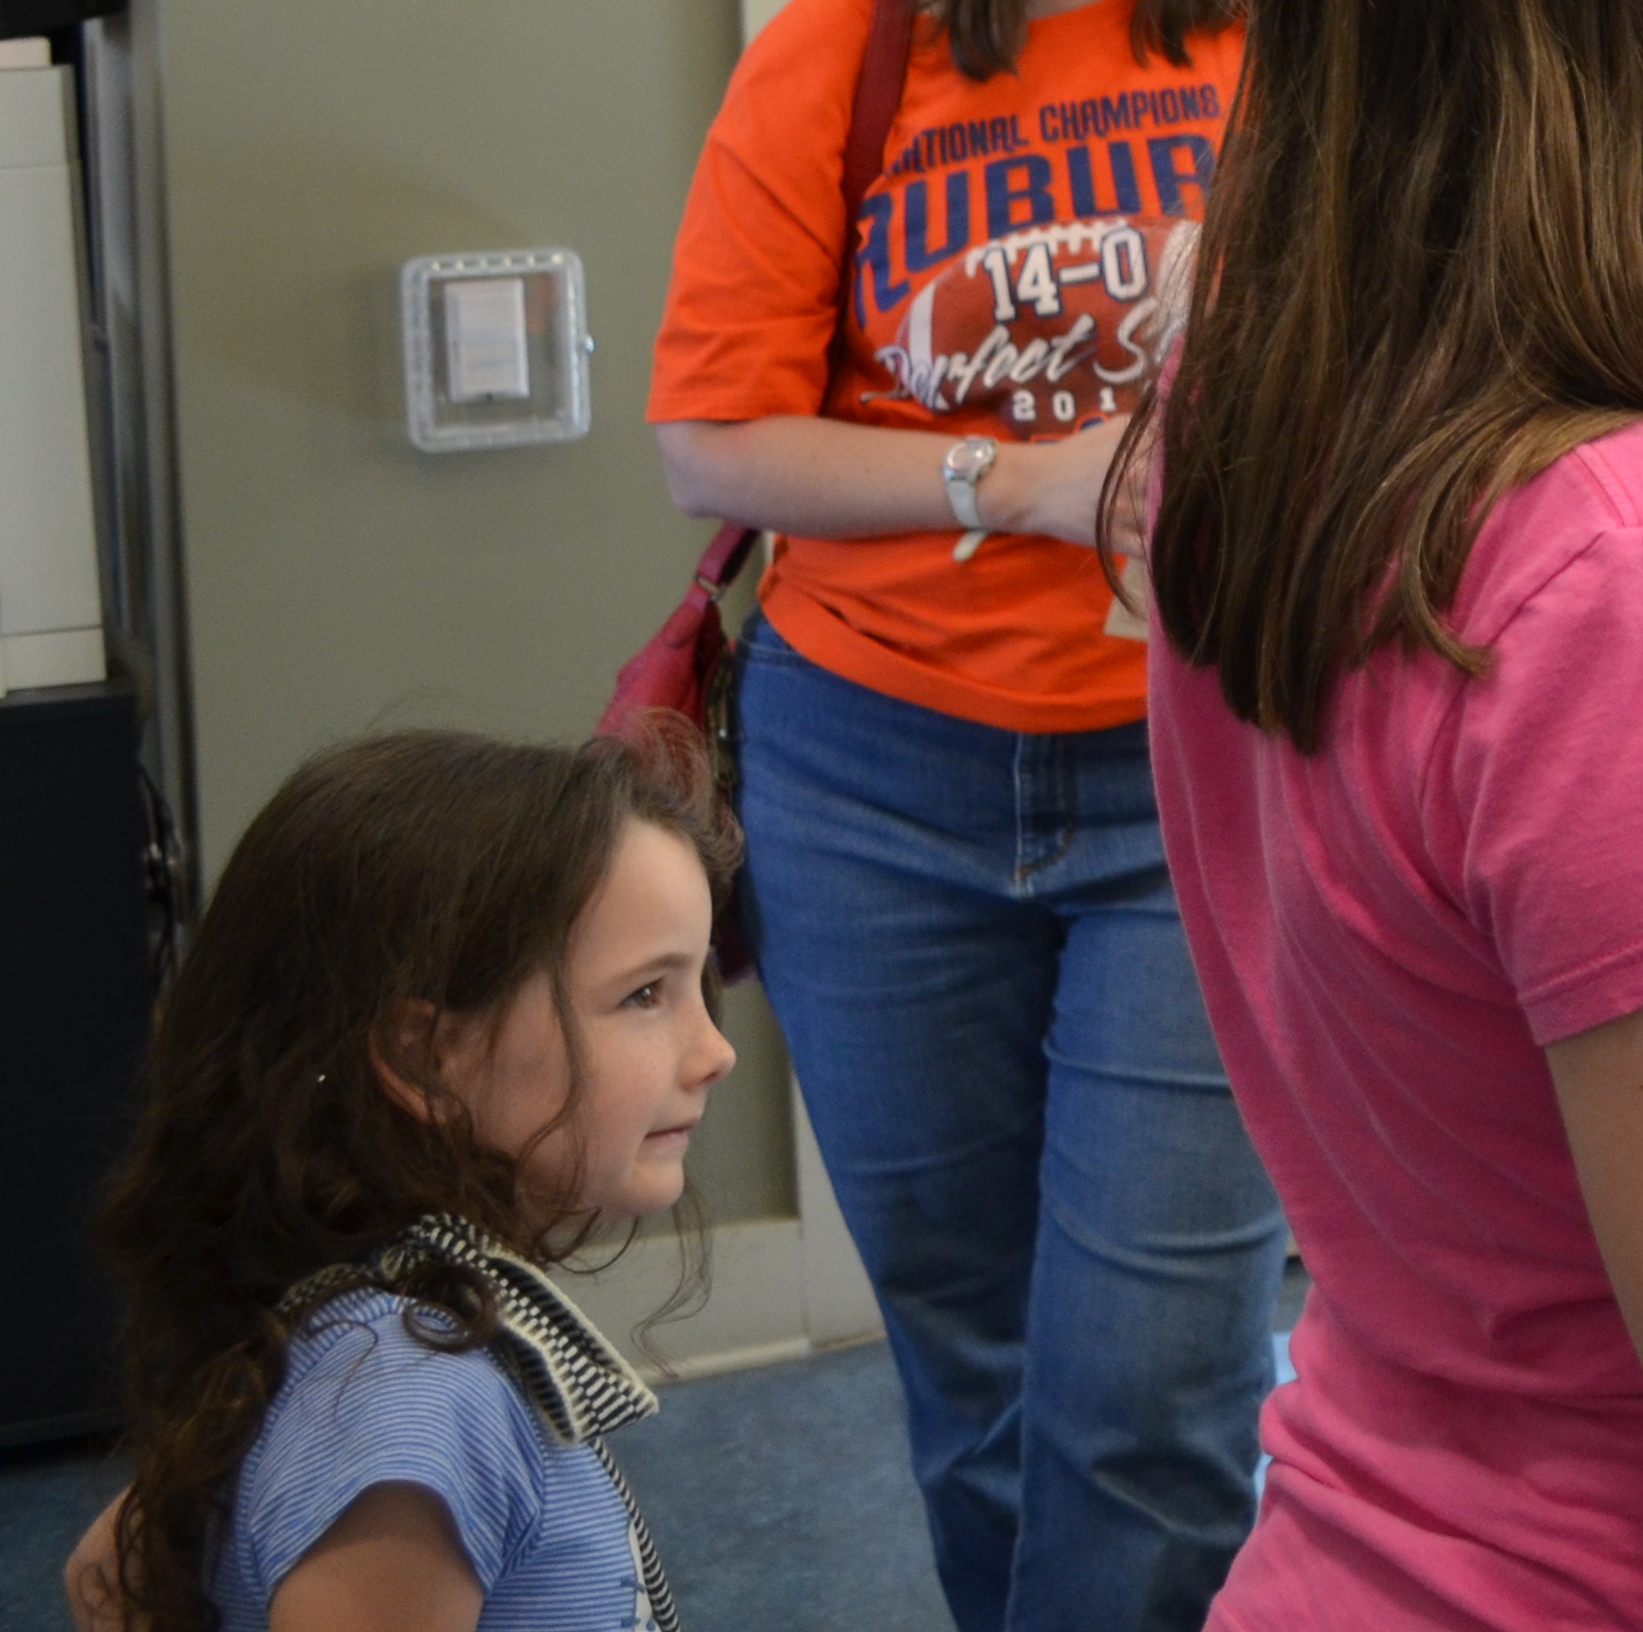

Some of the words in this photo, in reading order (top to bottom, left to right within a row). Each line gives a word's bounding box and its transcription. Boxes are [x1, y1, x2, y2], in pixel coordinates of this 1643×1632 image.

[1038, 84, 1221, 143] CHAMPIONS
[855, 133, 1217, 330] AUBUR
[983, 225, 1149, 323] 14-0
[860, 313, 1098, 412] Perfect
[1012, 386, 1119, 421] 201
